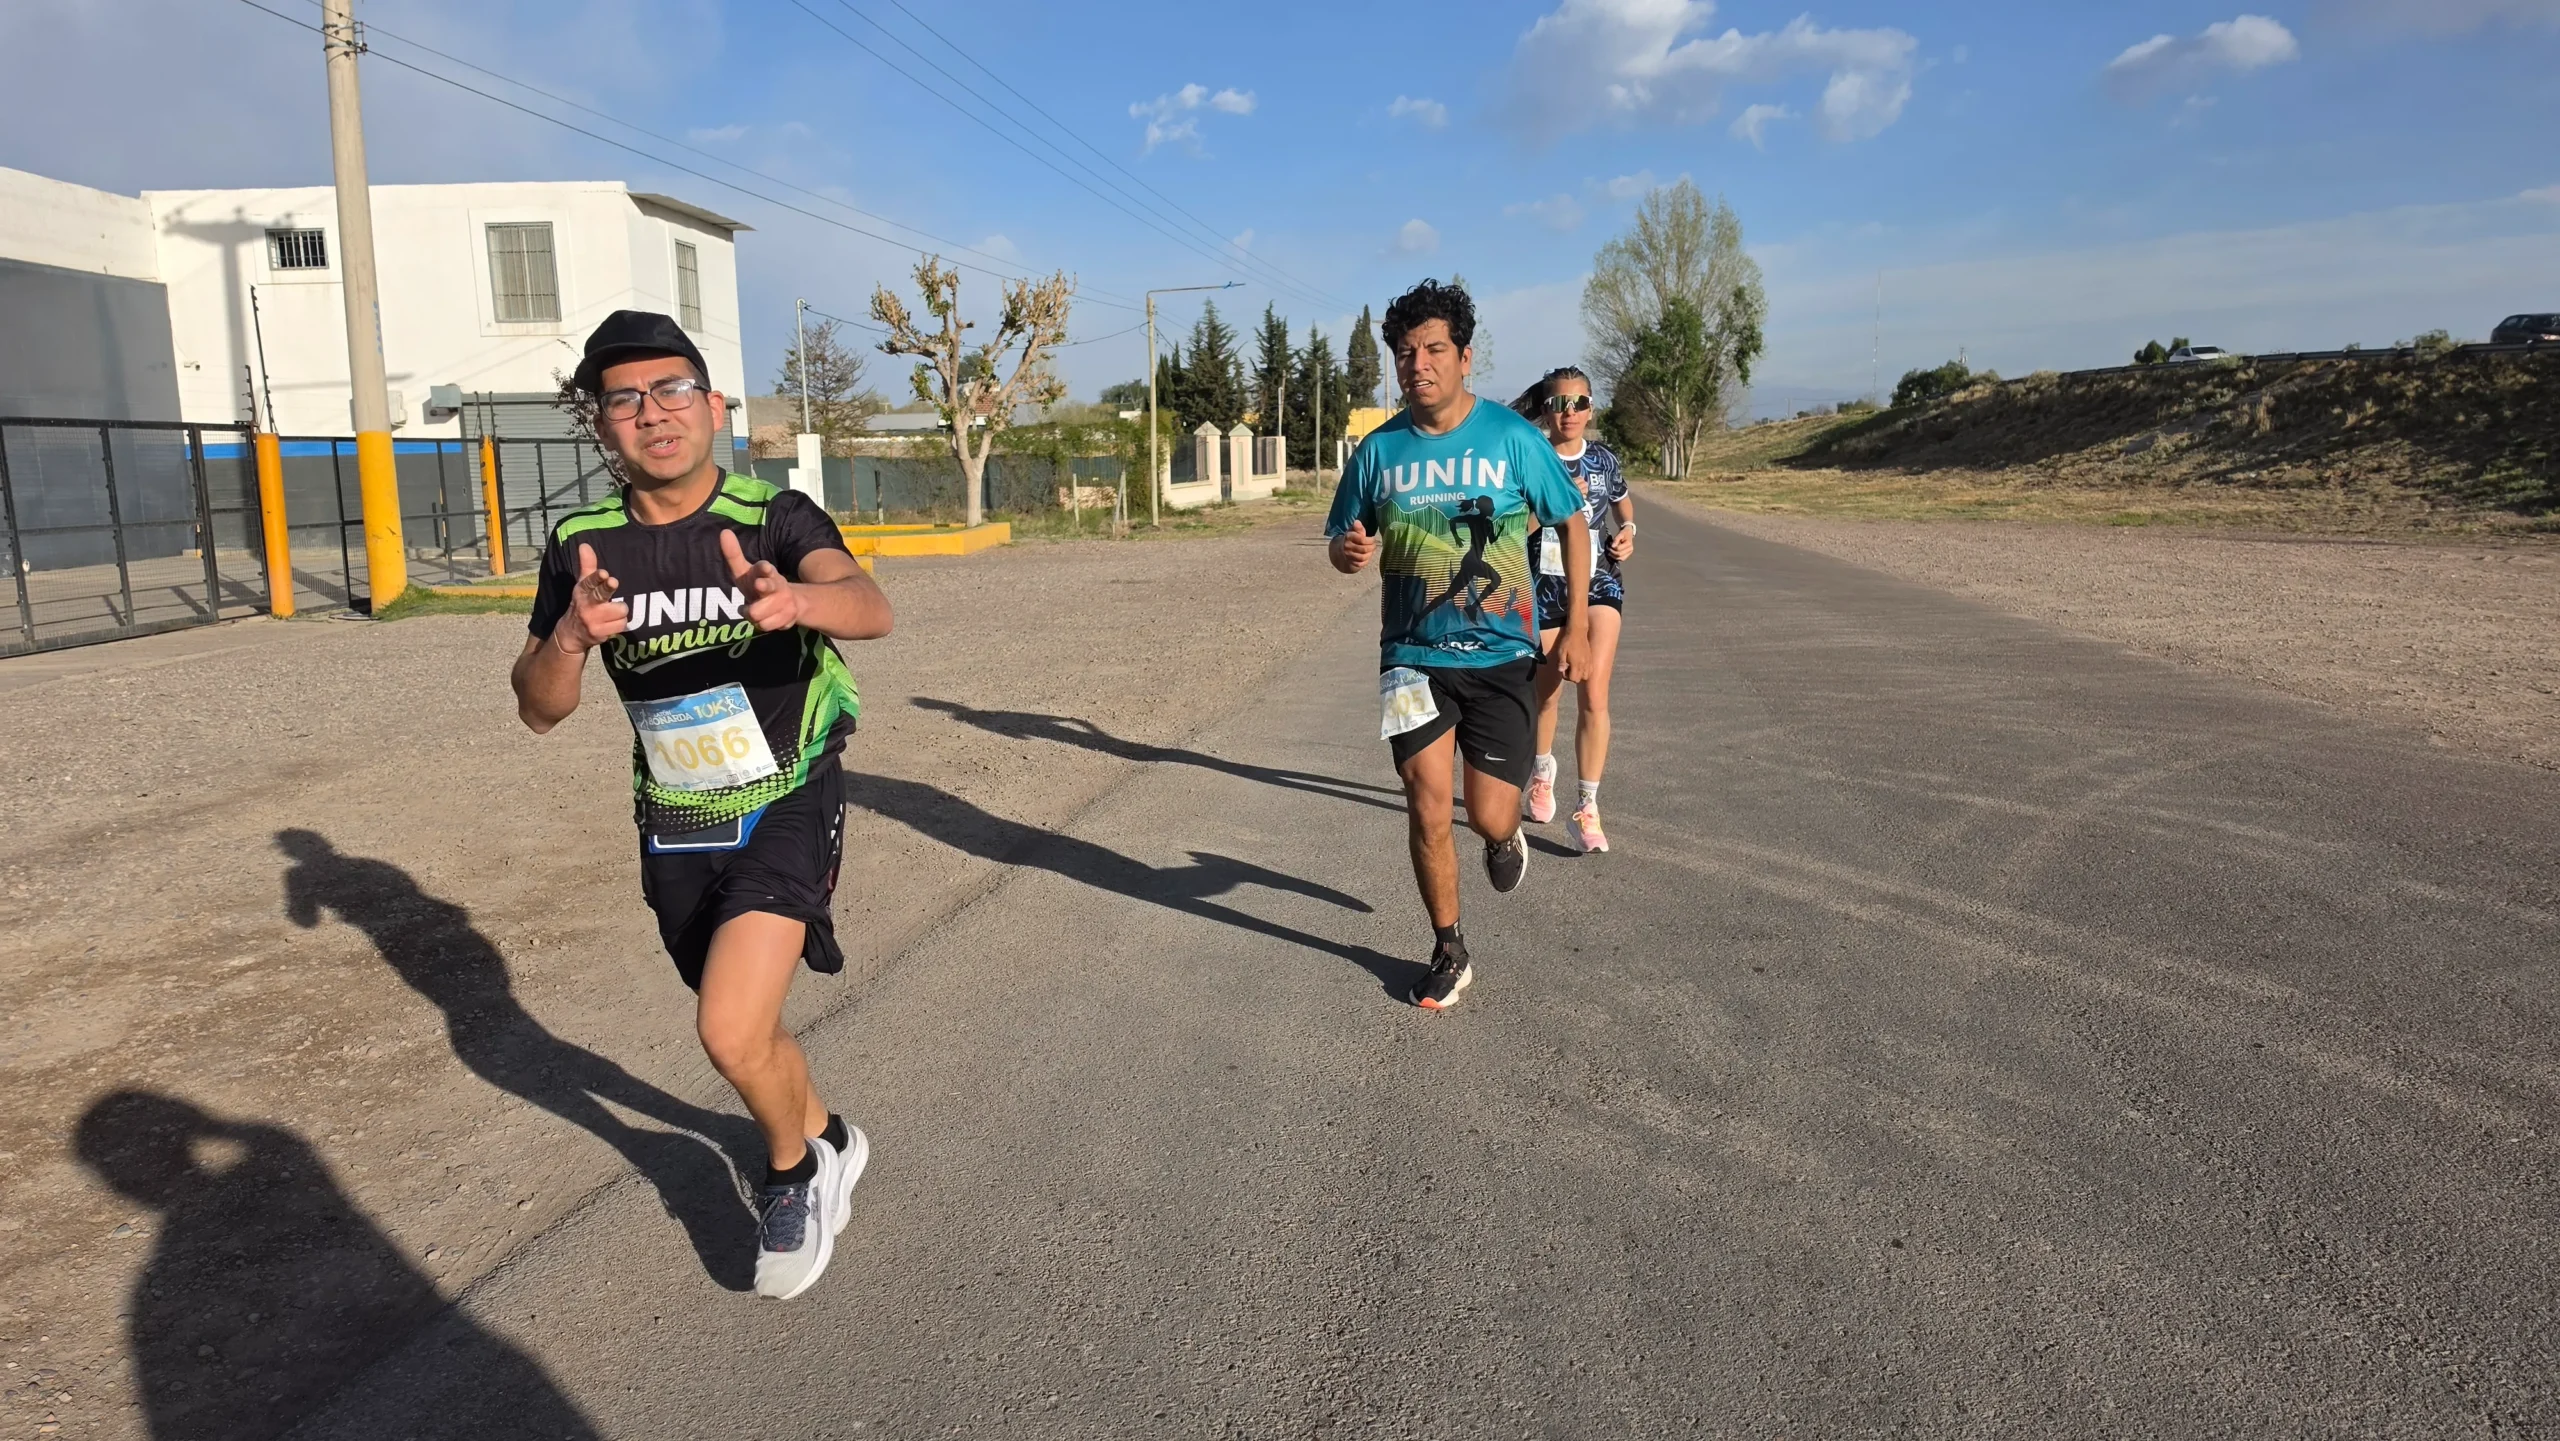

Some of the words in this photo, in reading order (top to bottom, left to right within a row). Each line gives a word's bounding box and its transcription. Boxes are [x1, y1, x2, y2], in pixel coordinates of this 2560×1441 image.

[1381, 448, 1506, 499] JUNÍN
[1410, 492, 1466, 505] RUNNING
[610, 587, 746, 632] UNIN
[610, 619, 755, 669] Running
[649, 712, 694, 726] BONARDA
[693, 699, 727, 719] 10K
[653, 726, 750, 770] 1066
